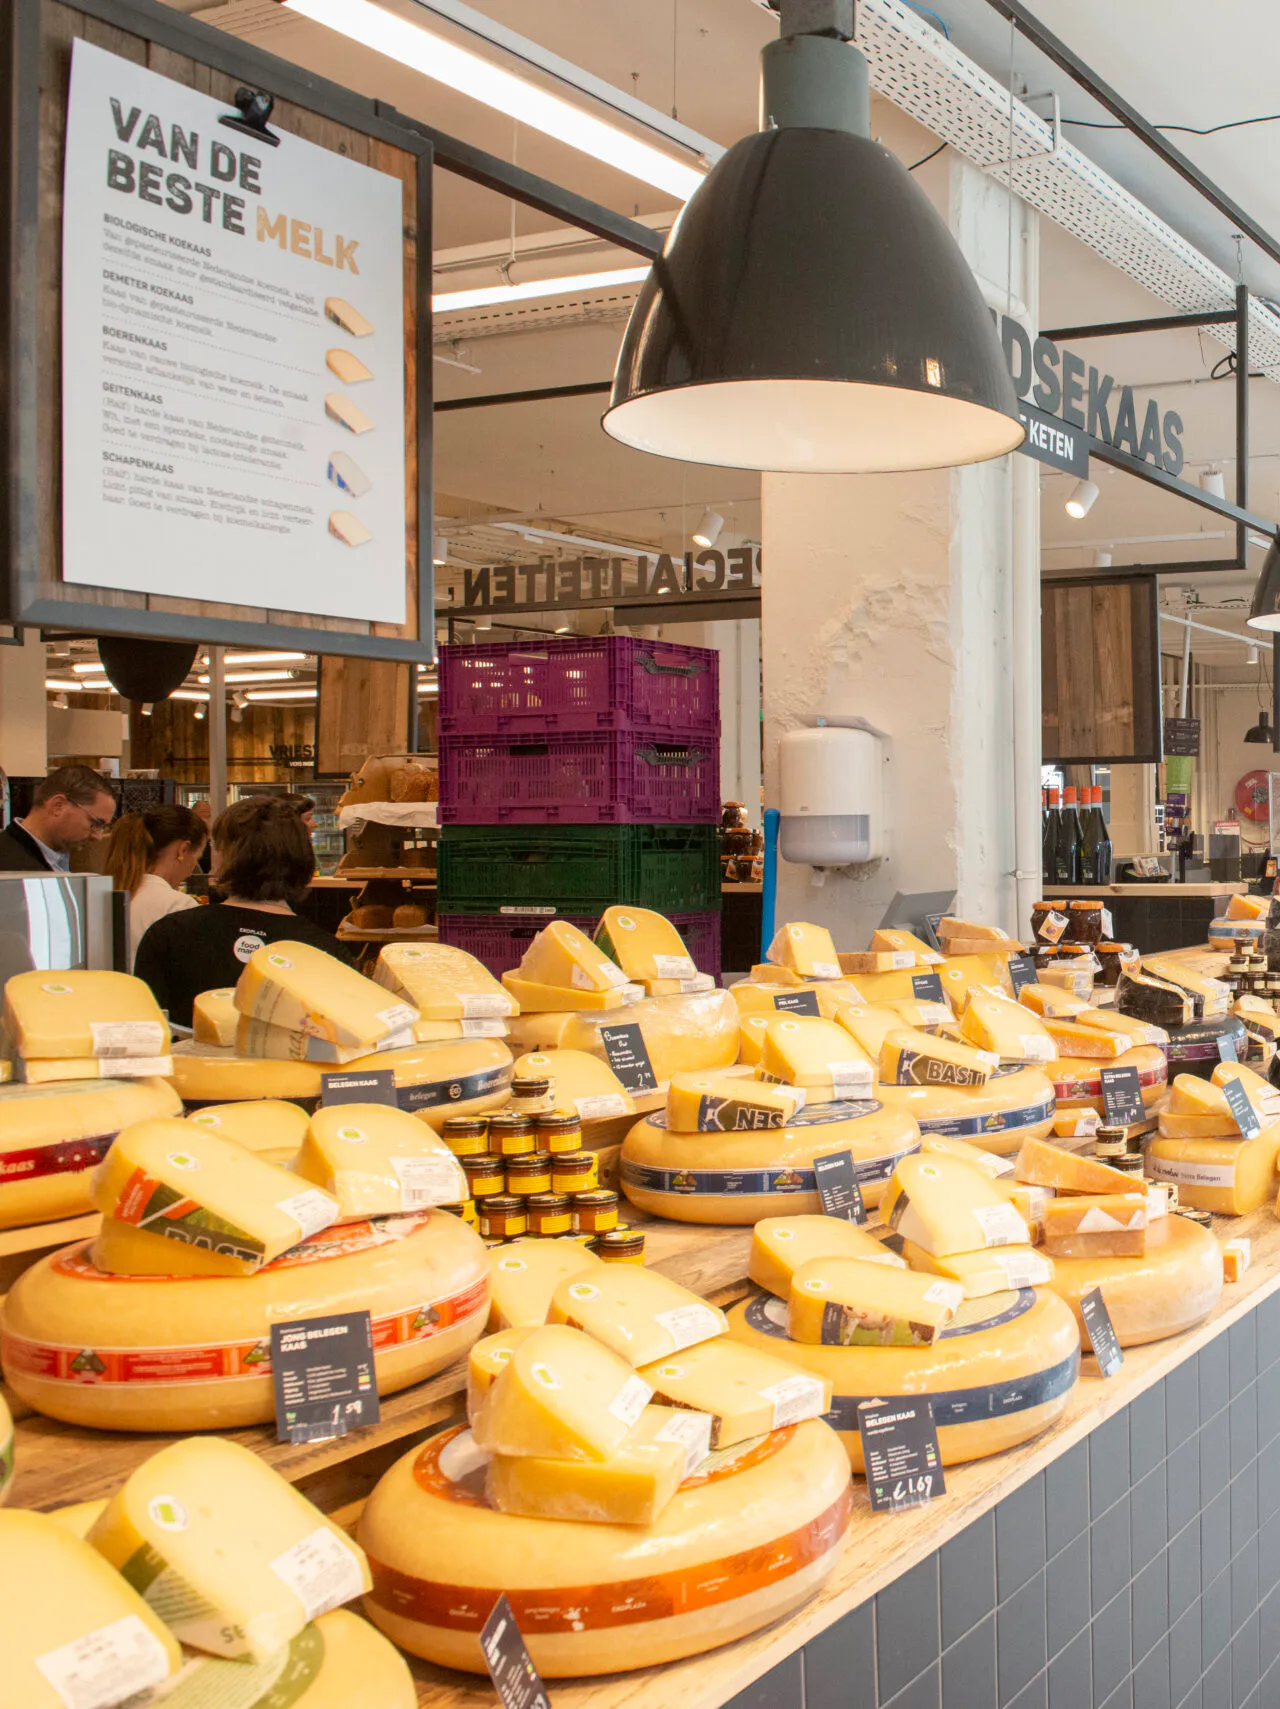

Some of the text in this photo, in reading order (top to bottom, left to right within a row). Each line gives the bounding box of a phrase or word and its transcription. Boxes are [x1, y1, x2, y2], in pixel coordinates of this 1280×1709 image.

[109, 96, 262, 195] VAN DE
[106, 148, 360, 276] BESTE MELK
[103, 213, 211, 257] BIOLOGISCHE KOEKAAS
[102, 269, 193, 305] DEMETER KOEKAAS
[102, 325, 167, 351] BOERENKAAS
[102, 381, 162, 404] GEITENKAAS
[988, 307, 1183, 476] DSEKAAS
[1029, 418, 1074, 461] KETEN
[102, 451, 173, 474] SCHAPENKAAS
[241, 941, 260, 950] food
[328, 1079, 379, 1089] BELEGEN KAAS
[280, 1332, 306, 1344] JONG
[307, 1326, 349, 1340] BELEGEN
[280, 1341, 308, 1352] KAAS
[866, 1410, 916, 1428] BELEGEN KAAS
